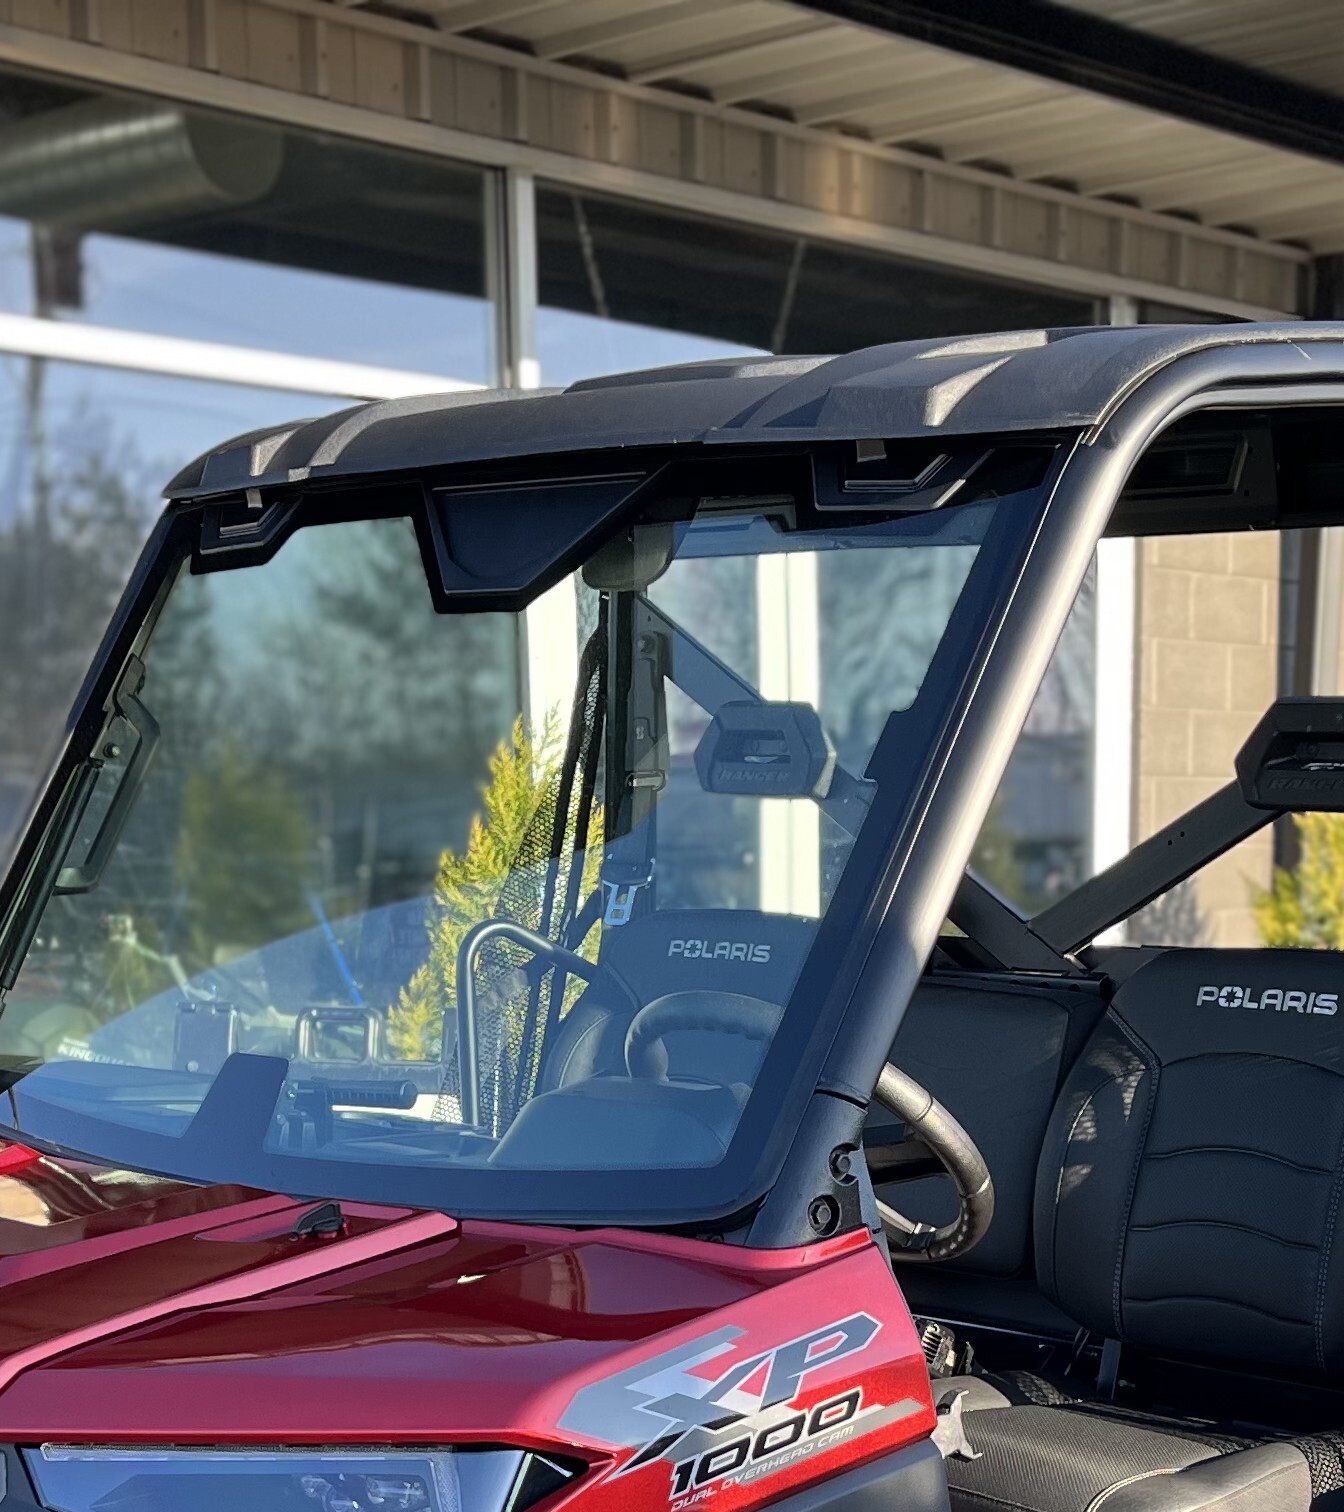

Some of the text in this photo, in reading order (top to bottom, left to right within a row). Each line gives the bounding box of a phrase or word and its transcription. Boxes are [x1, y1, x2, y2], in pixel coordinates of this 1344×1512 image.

[668, 940, 771, 962] POLARIS
[1196, 986, 1339, 1015] POLARIS
[601, 1311, 883, 1485] XP
[669, 1386, 864, 1501] 1000
[670, 1424, 855, 1512] DUAL OVERHEAD CAM
